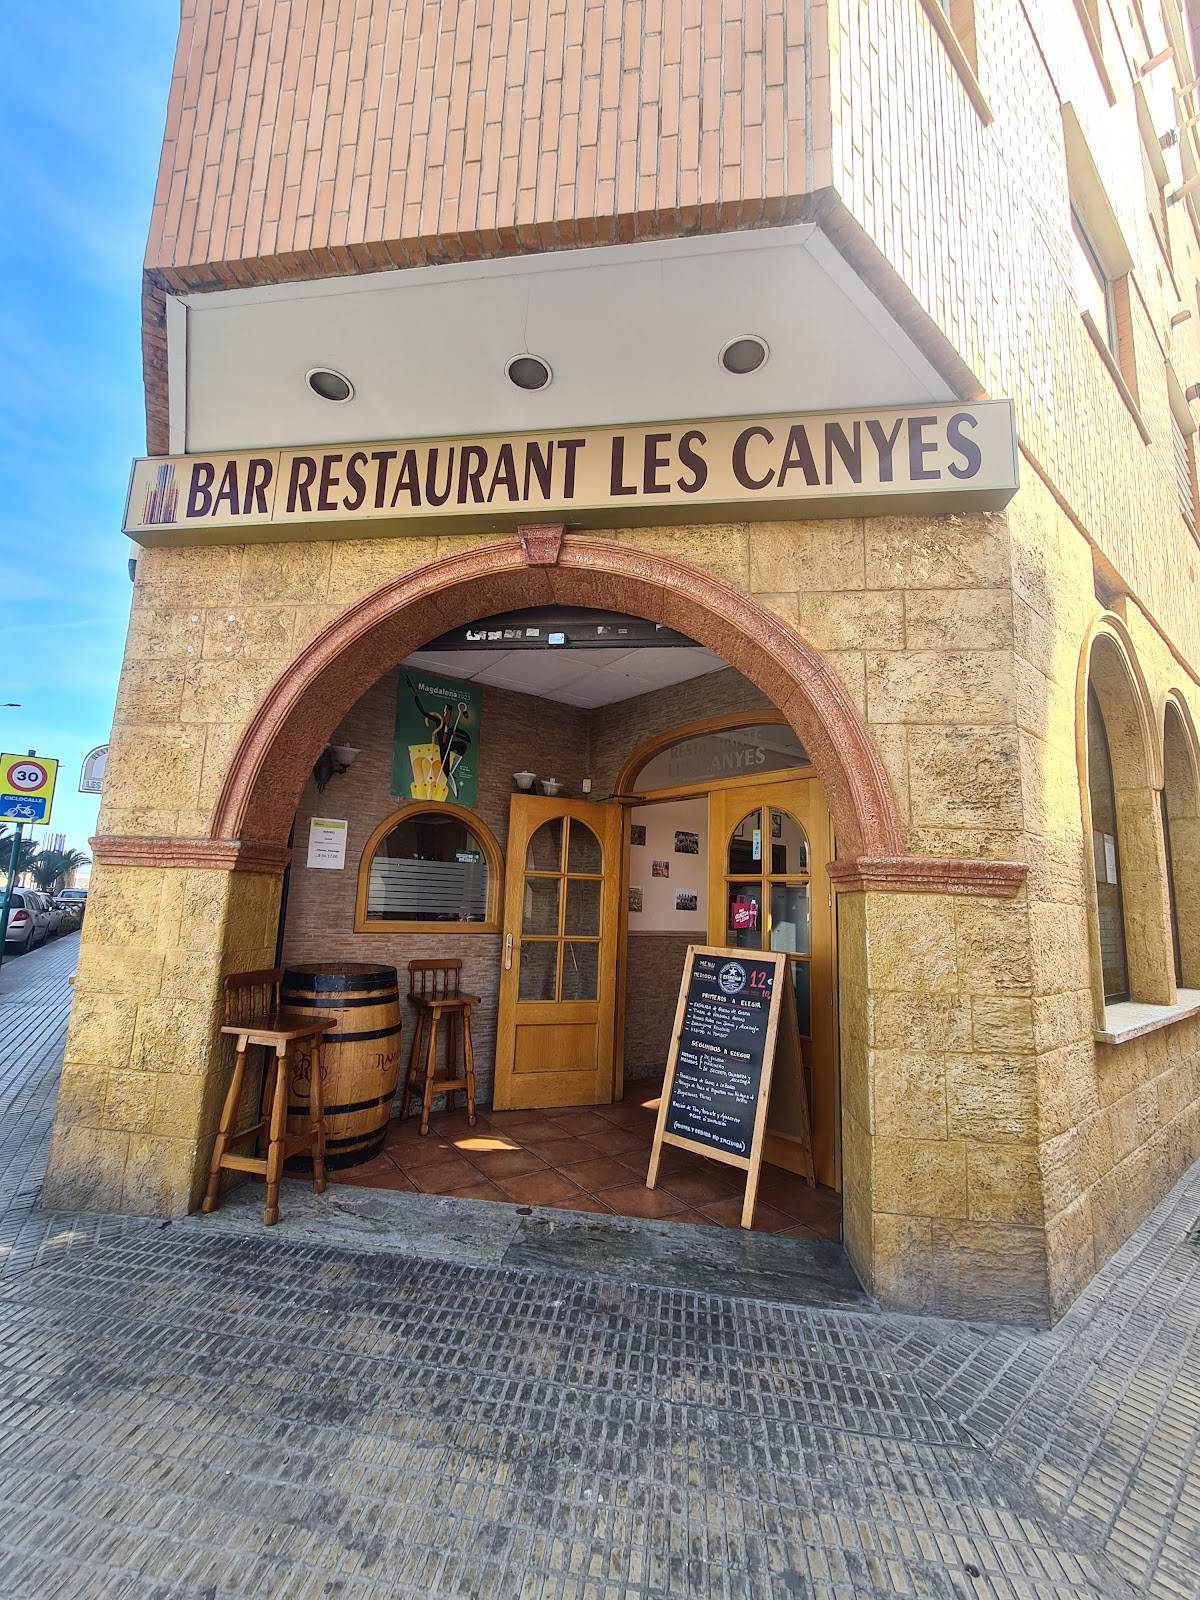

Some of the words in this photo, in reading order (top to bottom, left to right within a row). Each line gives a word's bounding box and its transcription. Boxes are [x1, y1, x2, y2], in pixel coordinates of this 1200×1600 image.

[185, 458, 273, 518] BAR
[286, 438, 586, 513] RESTAURANT
[610, 429, 708, 497] LES
[731, 412, 983, 492] CANYES
[418, 682, 458, 698] Magdalena
[17, 770, 38, 782] 30
[702, 992, 727, 1002] PRIMEROS
[741, 1000, 762, 1008] ELEGIR
[691, 1040, 721, 1052] SEGUNDOS
[730, 1051, 751, 1059] ELEGIR
